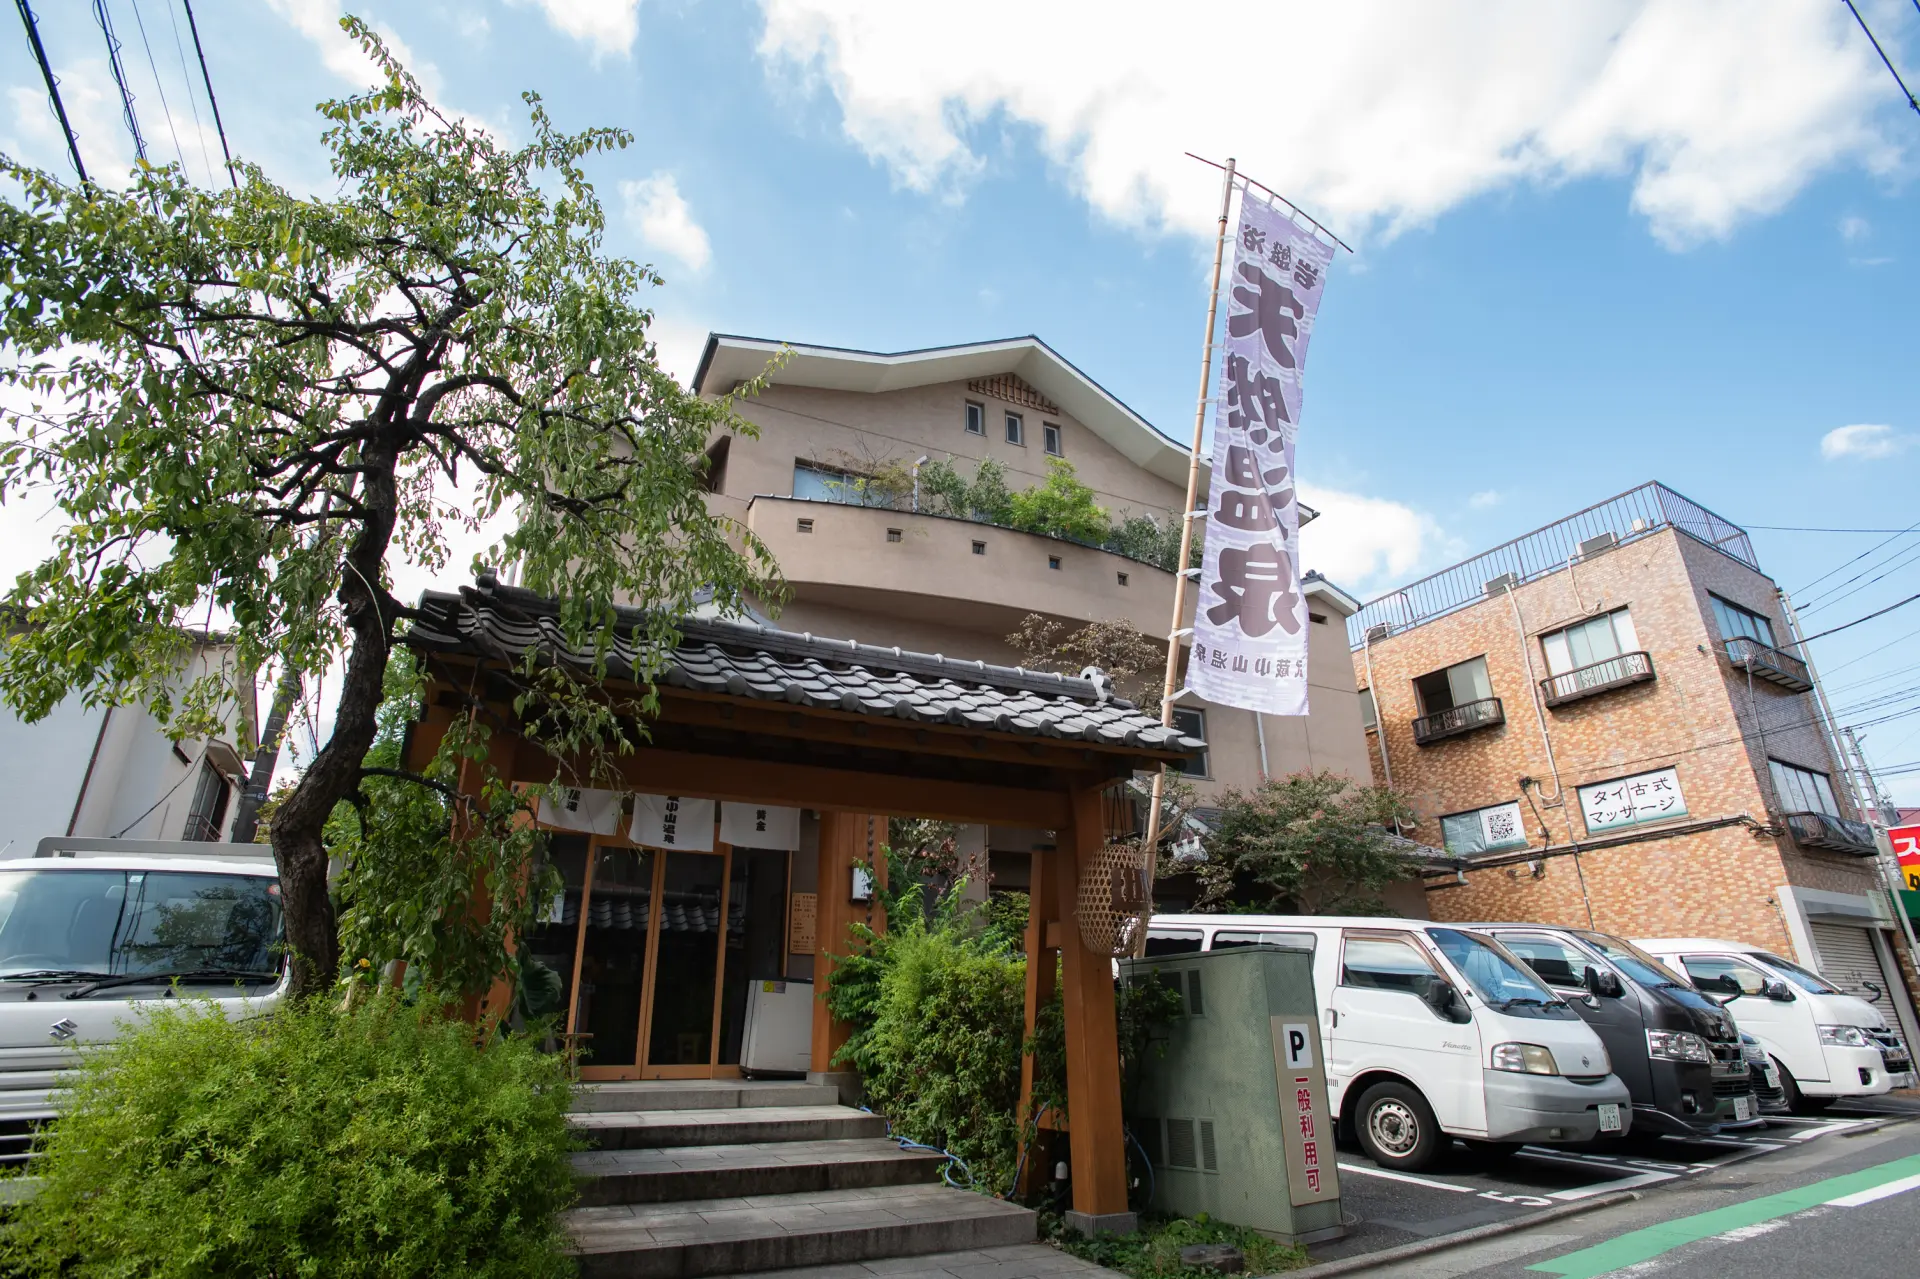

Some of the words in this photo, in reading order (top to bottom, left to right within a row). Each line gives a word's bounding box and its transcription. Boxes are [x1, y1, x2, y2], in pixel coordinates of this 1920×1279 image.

[1594, 777, 1672, 805] タイ古式
[1589, 796, 1675, 823] マッサージ
[1289, 1030, 1304, 1062] P
[1295, 1075, 1320, 1194] 一般利用可
[1477, 1190, 1552, 1206] 5
